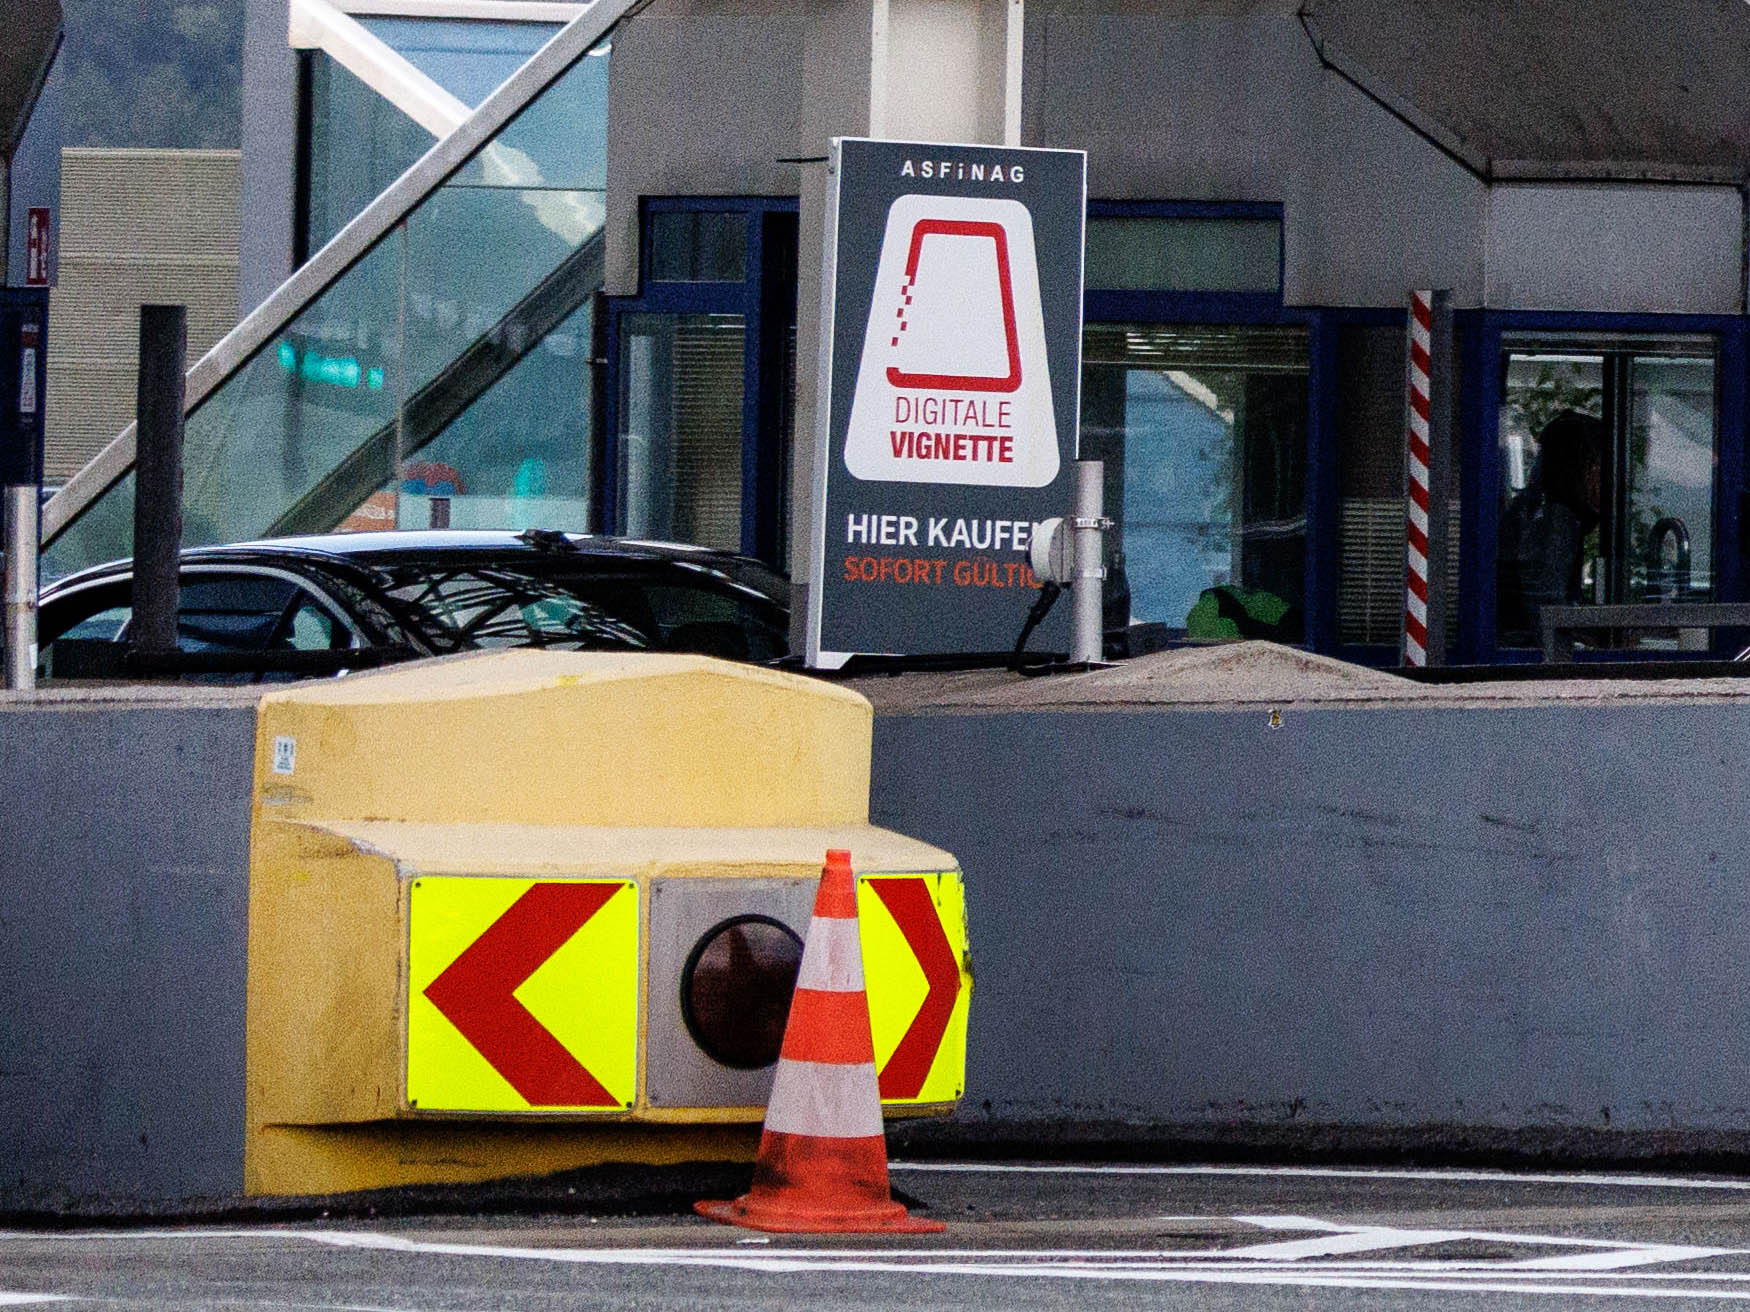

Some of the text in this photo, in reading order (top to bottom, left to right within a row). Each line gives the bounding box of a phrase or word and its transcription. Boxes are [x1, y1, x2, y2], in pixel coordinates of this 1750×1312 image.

[894, 394, 1013, 430] DIGITALE
[889, 431, 1015, 464] VIGNETTE
[846, 513, 1042, 552] HIER KAUFE
[843, 555, 947, 584] SOFORT
